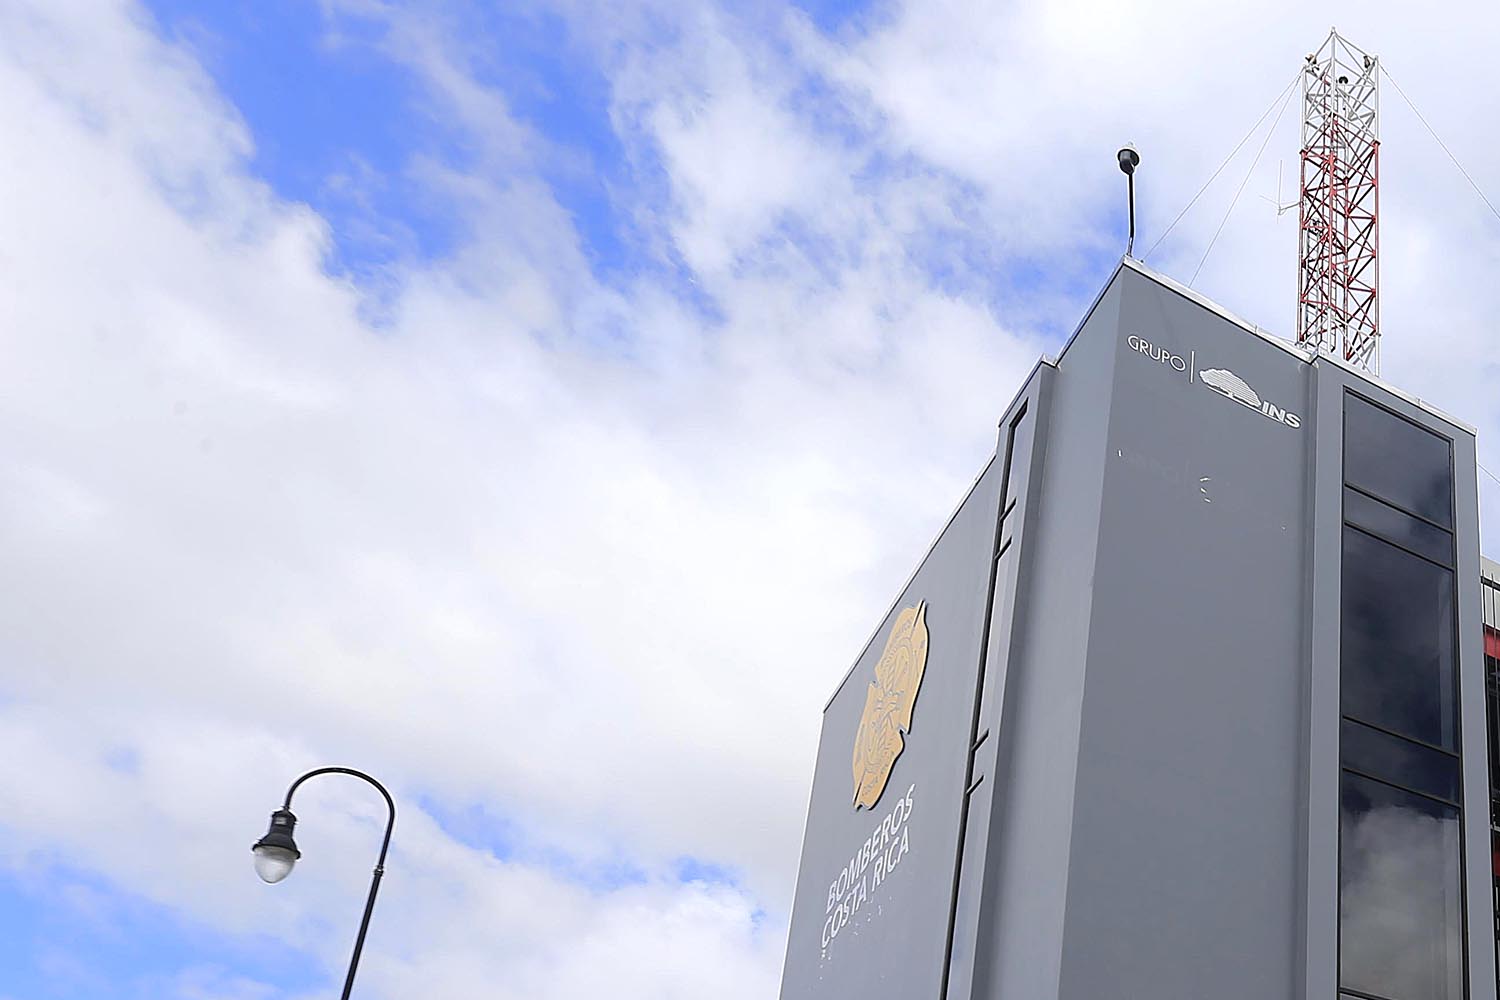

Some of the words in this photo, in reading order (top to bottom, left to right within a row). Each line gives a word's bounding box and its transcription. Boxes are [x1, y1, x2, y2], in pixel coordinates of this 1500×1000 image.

[1127, 335, 1187, 372] GRUPO
[1262, 400, 1302, 428] INS
[821, 875, 868, 949] COSTA
[872, 825, 910, 892] RICA
[826, 784, 916, 914] BOMBEROS
